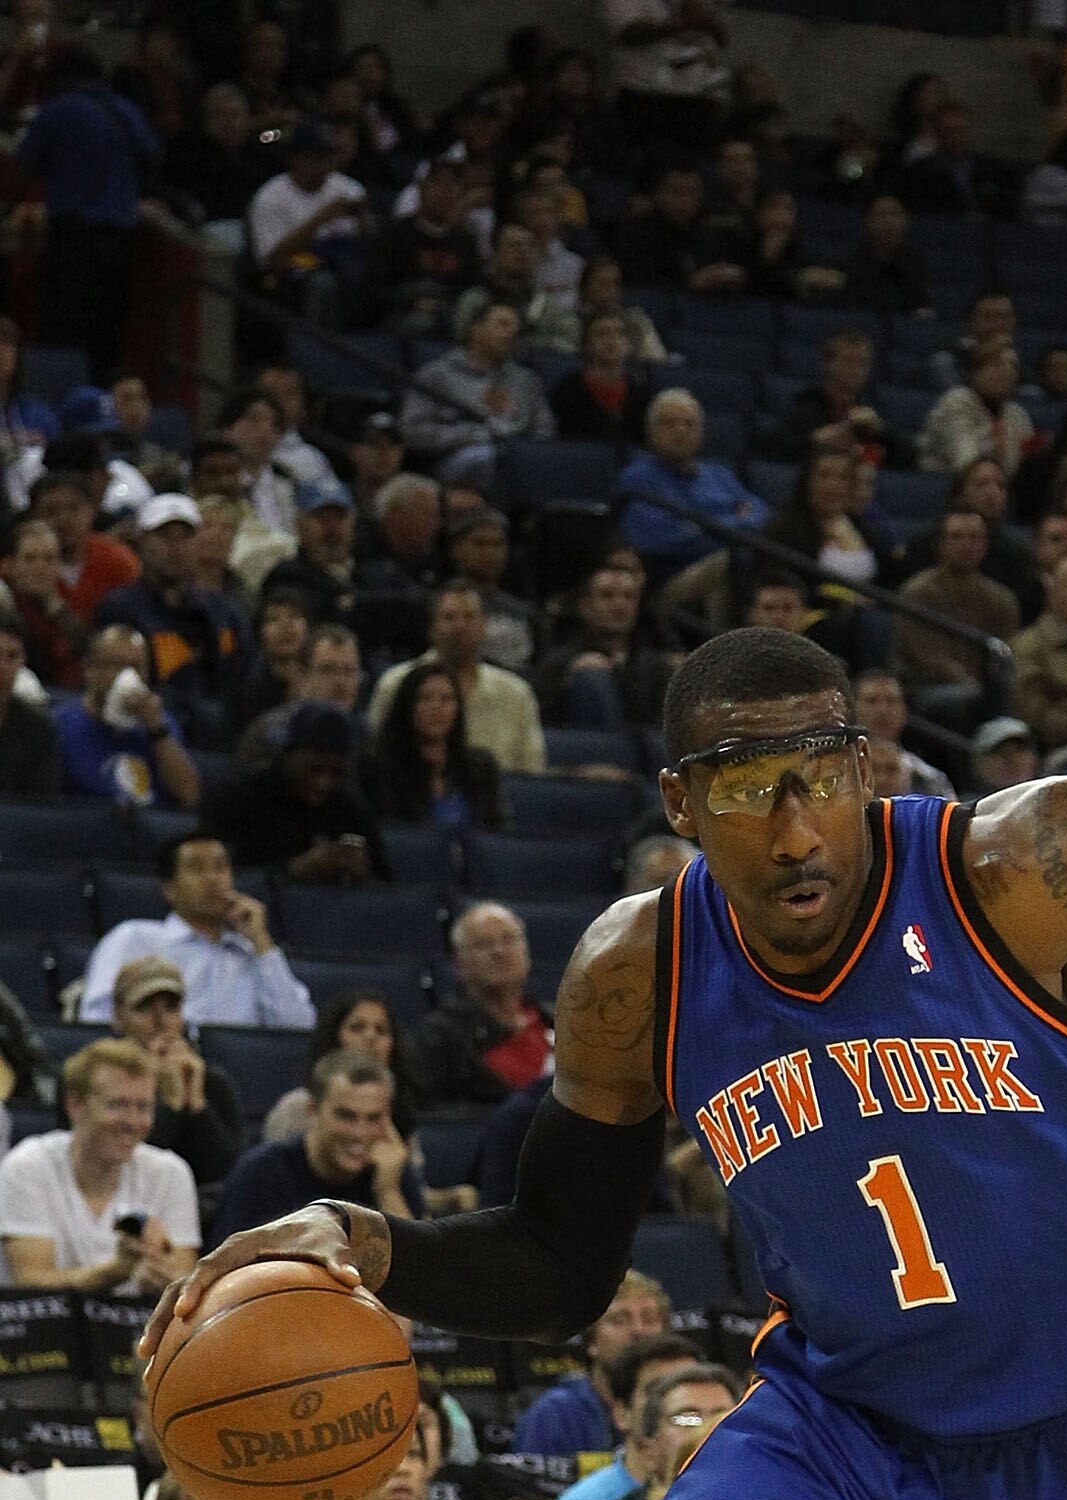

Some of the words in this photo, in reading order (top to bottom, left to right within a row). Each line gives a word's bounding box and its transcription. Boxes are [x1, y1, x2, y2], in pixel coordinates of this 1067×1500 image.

[696, 1048, 824, 1186] NEW
[825, 1037, 1045, 1118] YORK
[856, 1154, 957, 1310] 1
[217, 1389, 399, 1469] SPALDING
